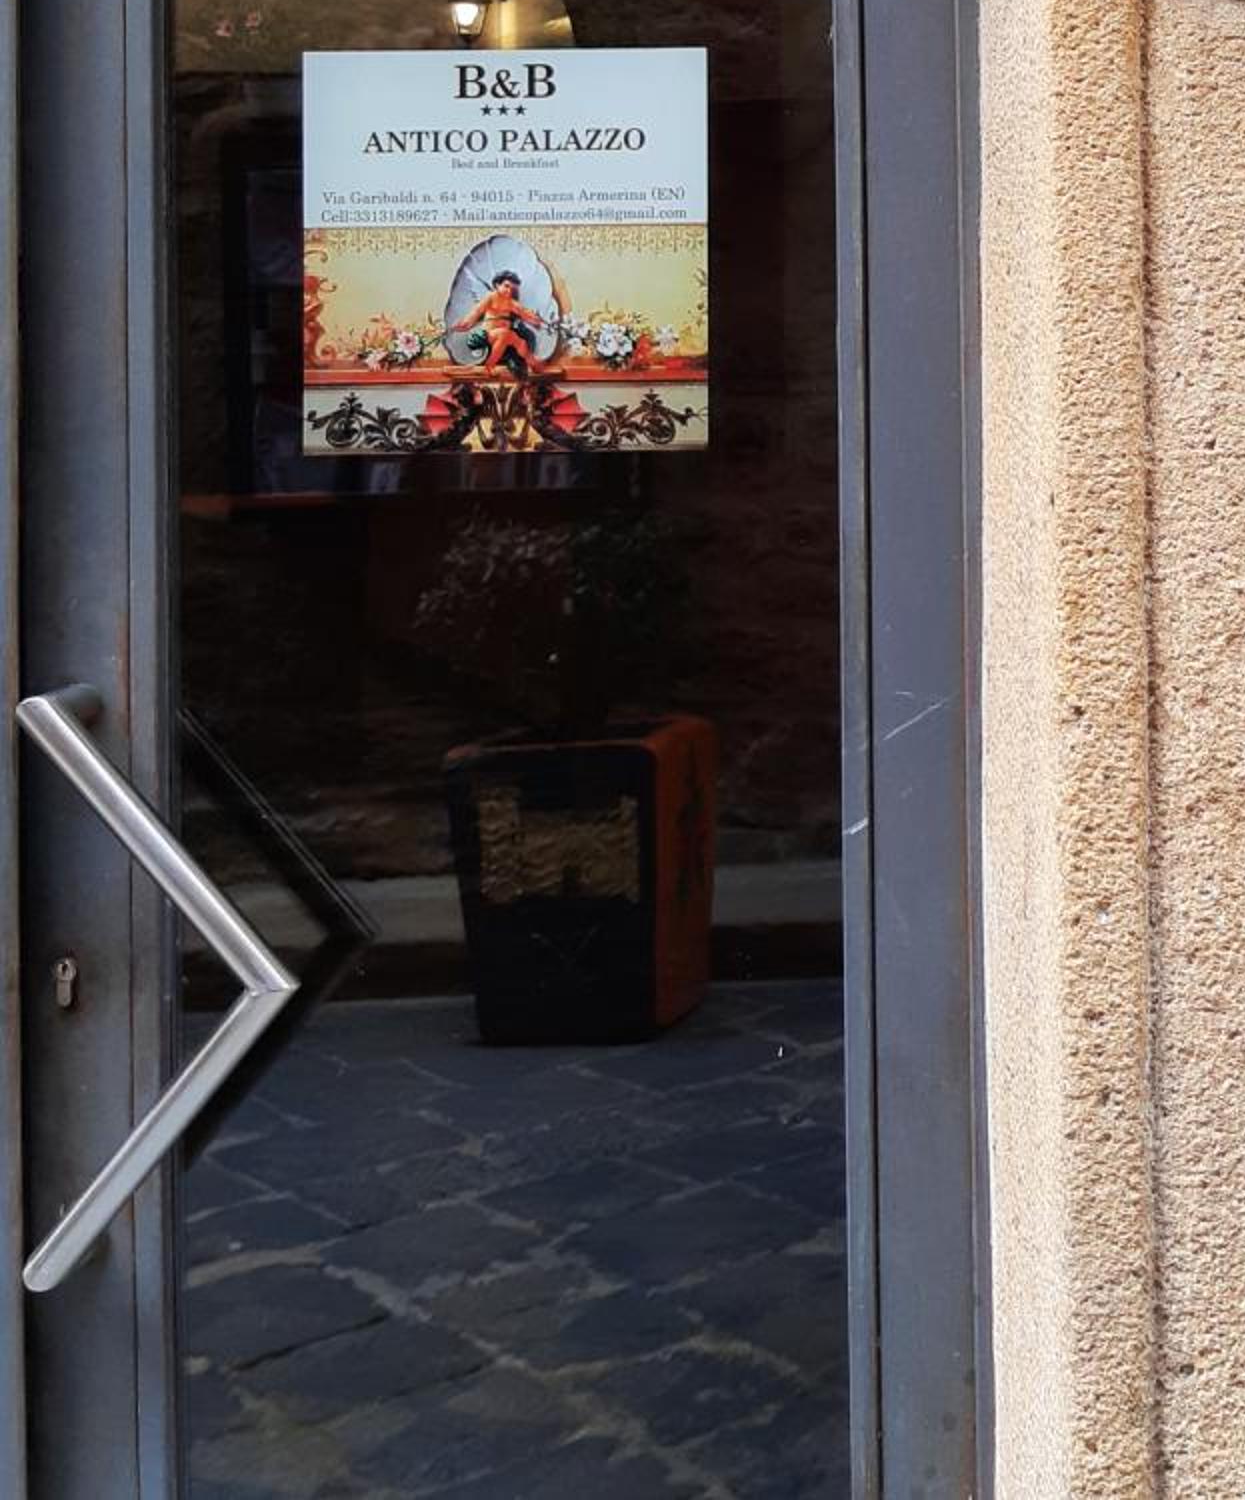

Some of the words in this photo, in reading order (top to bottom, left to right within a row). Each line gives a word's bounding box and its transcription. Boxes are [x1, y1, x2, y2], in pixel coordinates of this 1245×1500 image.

[454, 63, 557, 100] B&B
[363, 129, 488, 154] ANTICO
[501, 127, 646, 152] PALAZZO
[478, 157, 499, 169] and
[323, 191, 345, 205] Via
[351, 190, 418, 204] Garibaldi
[440, 190, 457, 203] 64
[471, 190, 514, 203] 94015
[528, 189, 575, 203] Piazza
[579, 187, 647, 202] Armerina
[651, 186, 686, 201] (EN)
